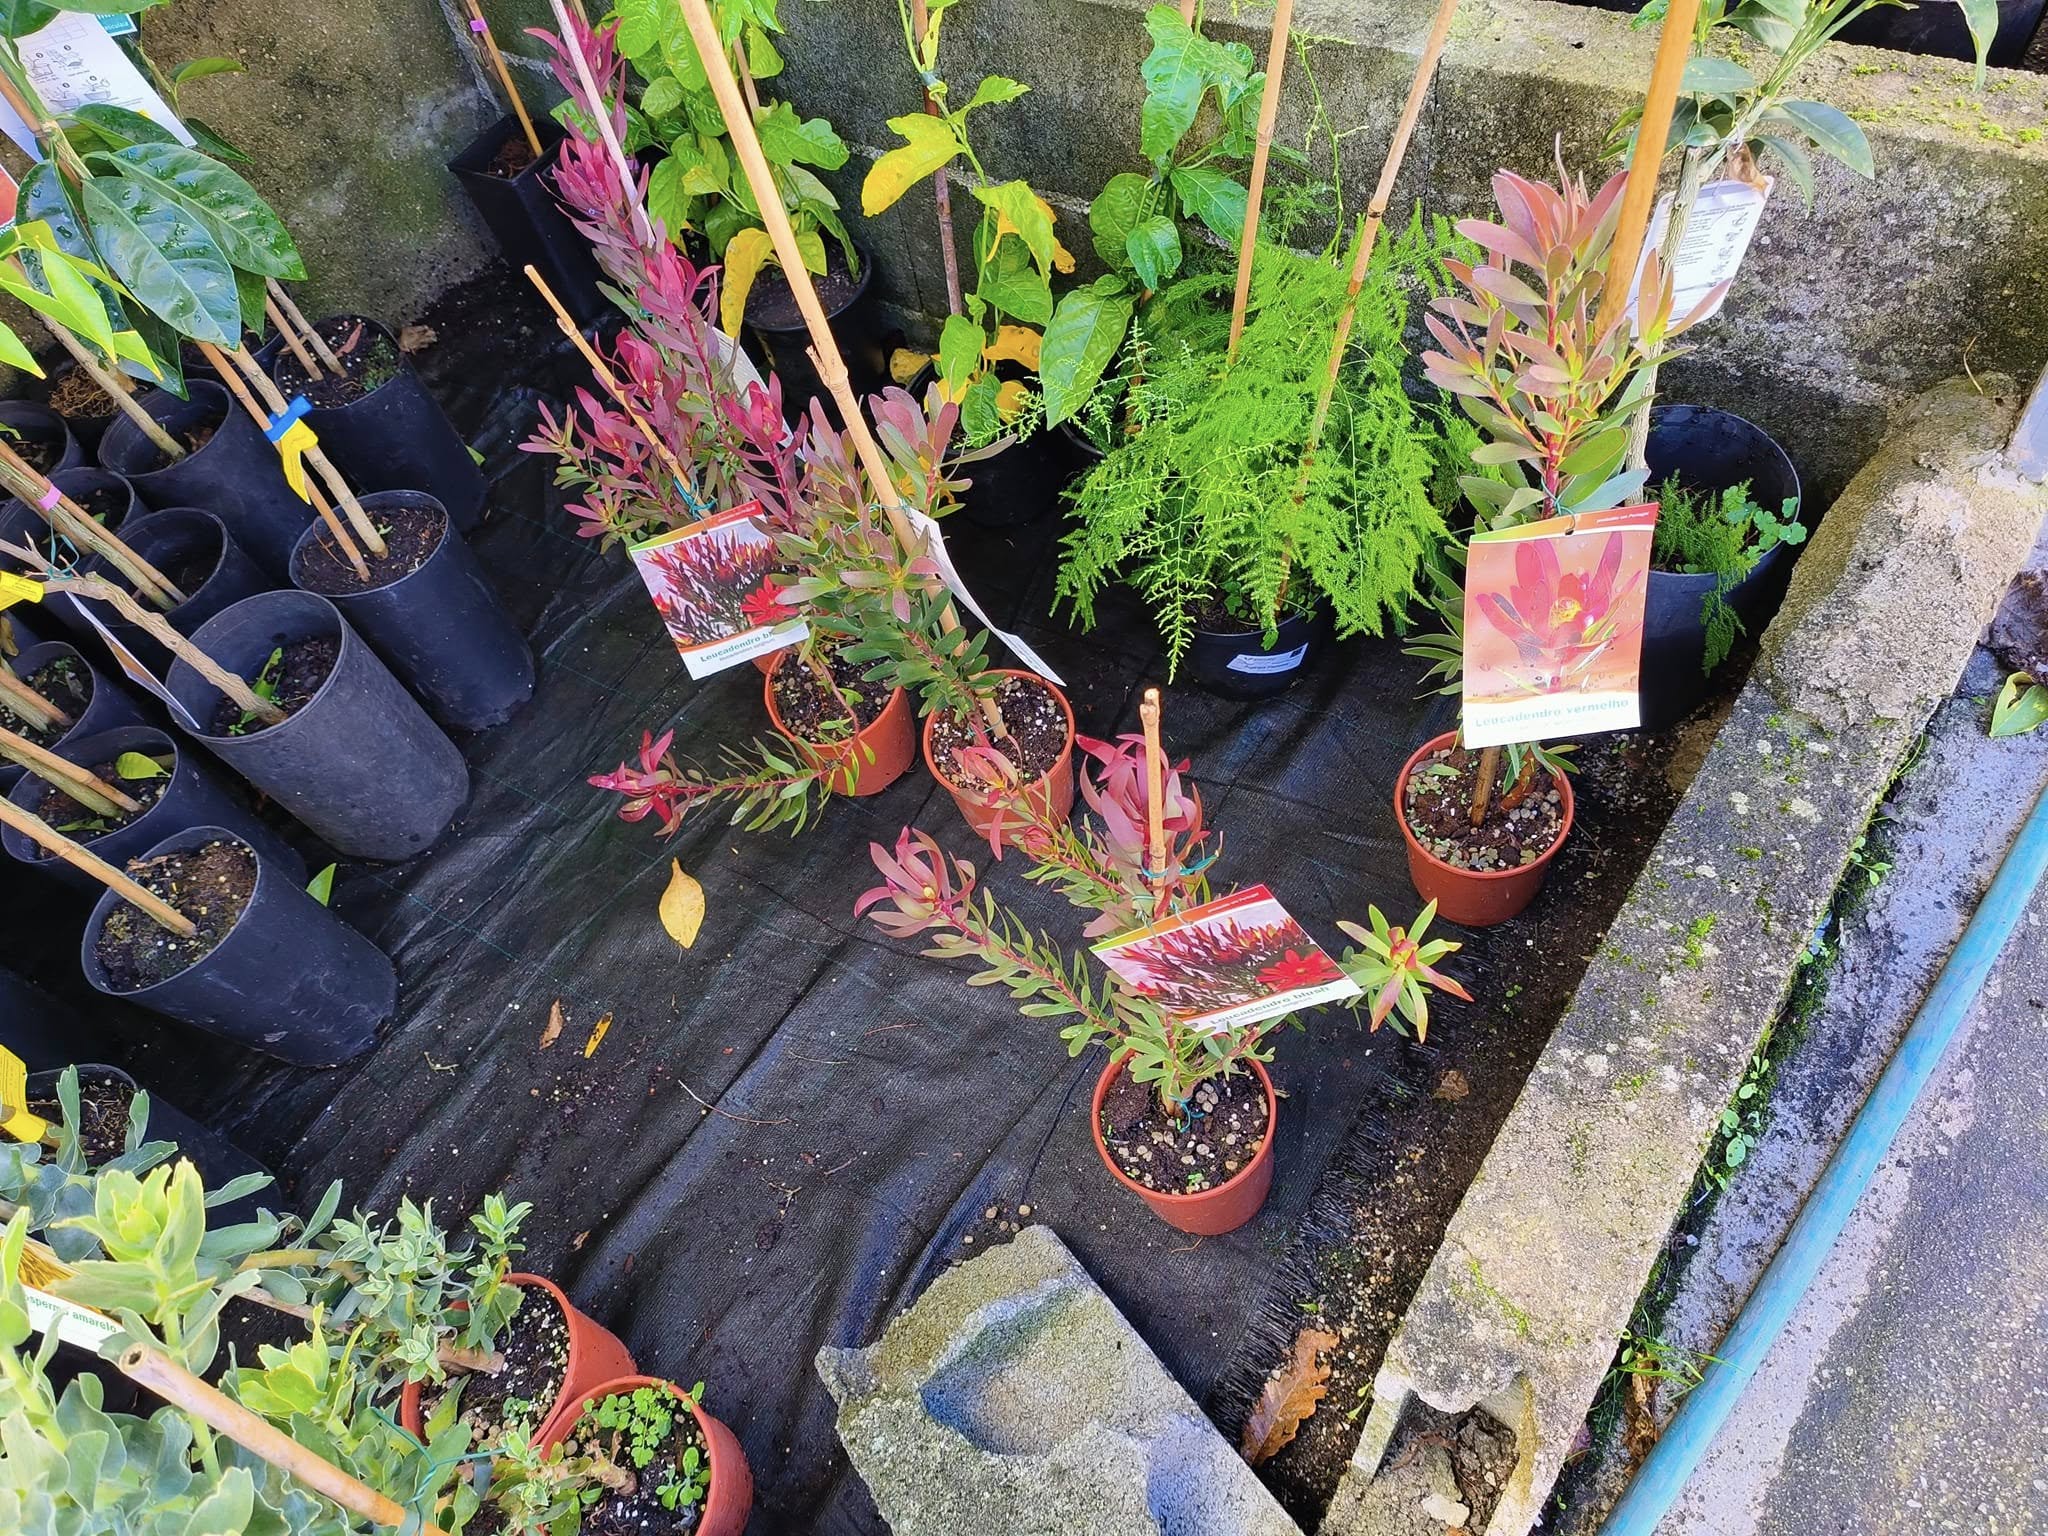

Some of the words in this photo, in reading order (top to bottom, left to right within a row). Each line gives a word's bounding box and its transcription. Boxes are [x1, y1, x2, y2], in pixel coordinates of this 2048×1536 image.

[700, 636, 761, 662] Leucadendro
[1475, 707, 1562, 728] Leucadendro
[1566, 698, 1630, 716] vermelho
[1293, 985, 1330, 1000] blush
[72, 1310, 117, 1334] amarelo
